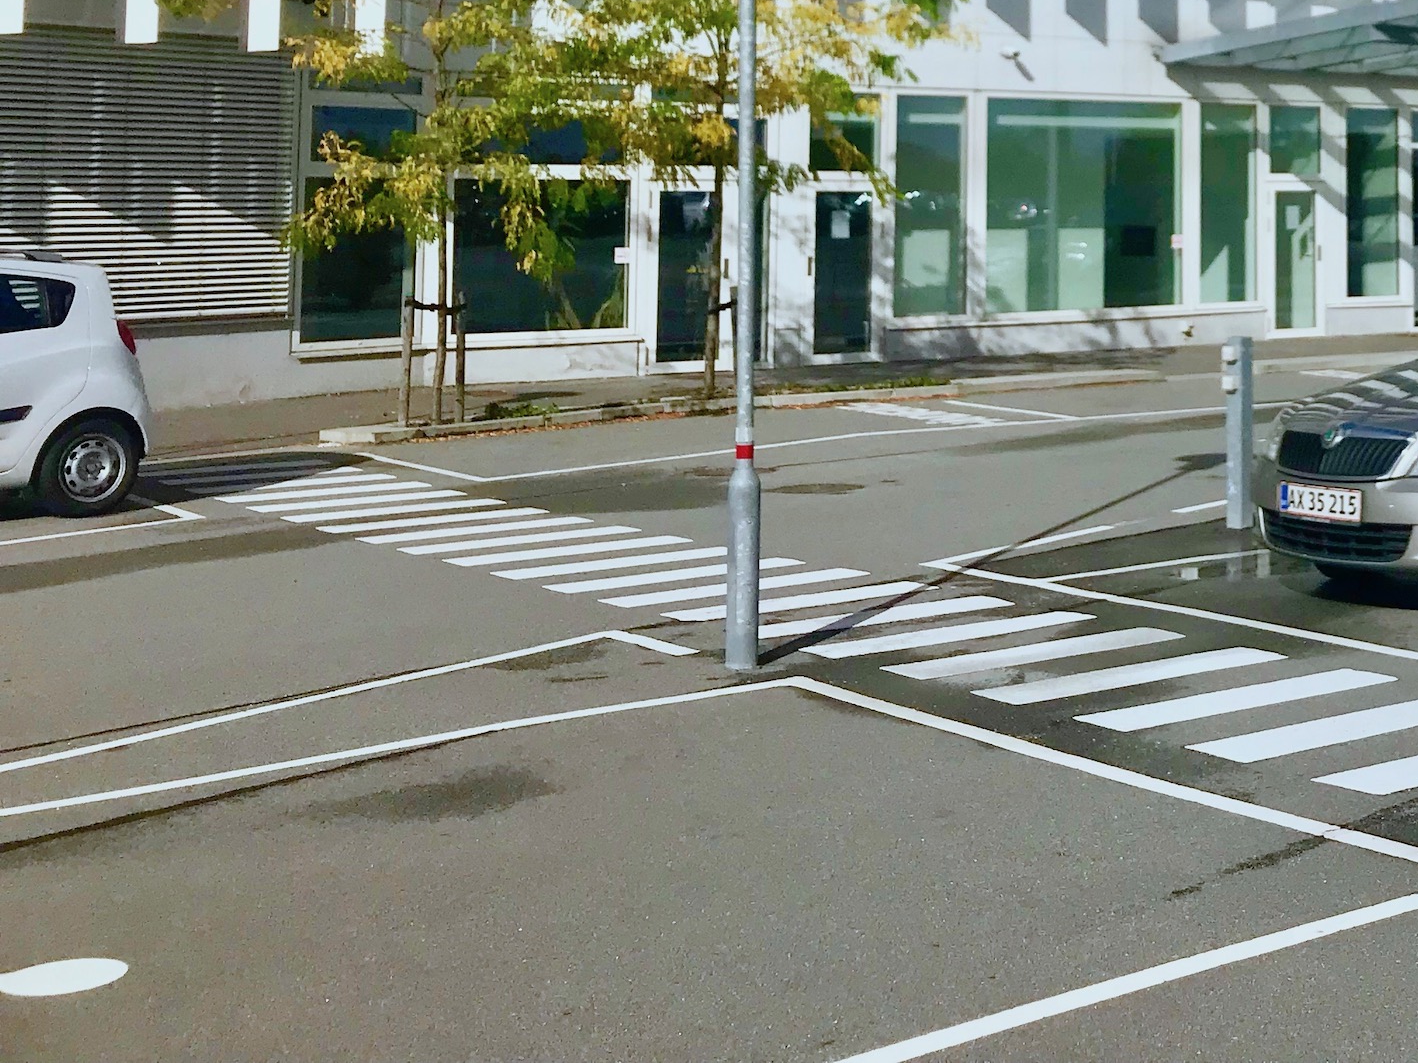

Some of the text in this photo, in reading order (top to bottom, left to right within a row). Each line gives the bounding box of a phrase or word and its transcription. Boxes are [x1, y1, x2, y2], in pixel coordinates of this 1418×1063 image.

[1289, 489, 1357, 515] AX 35 215
